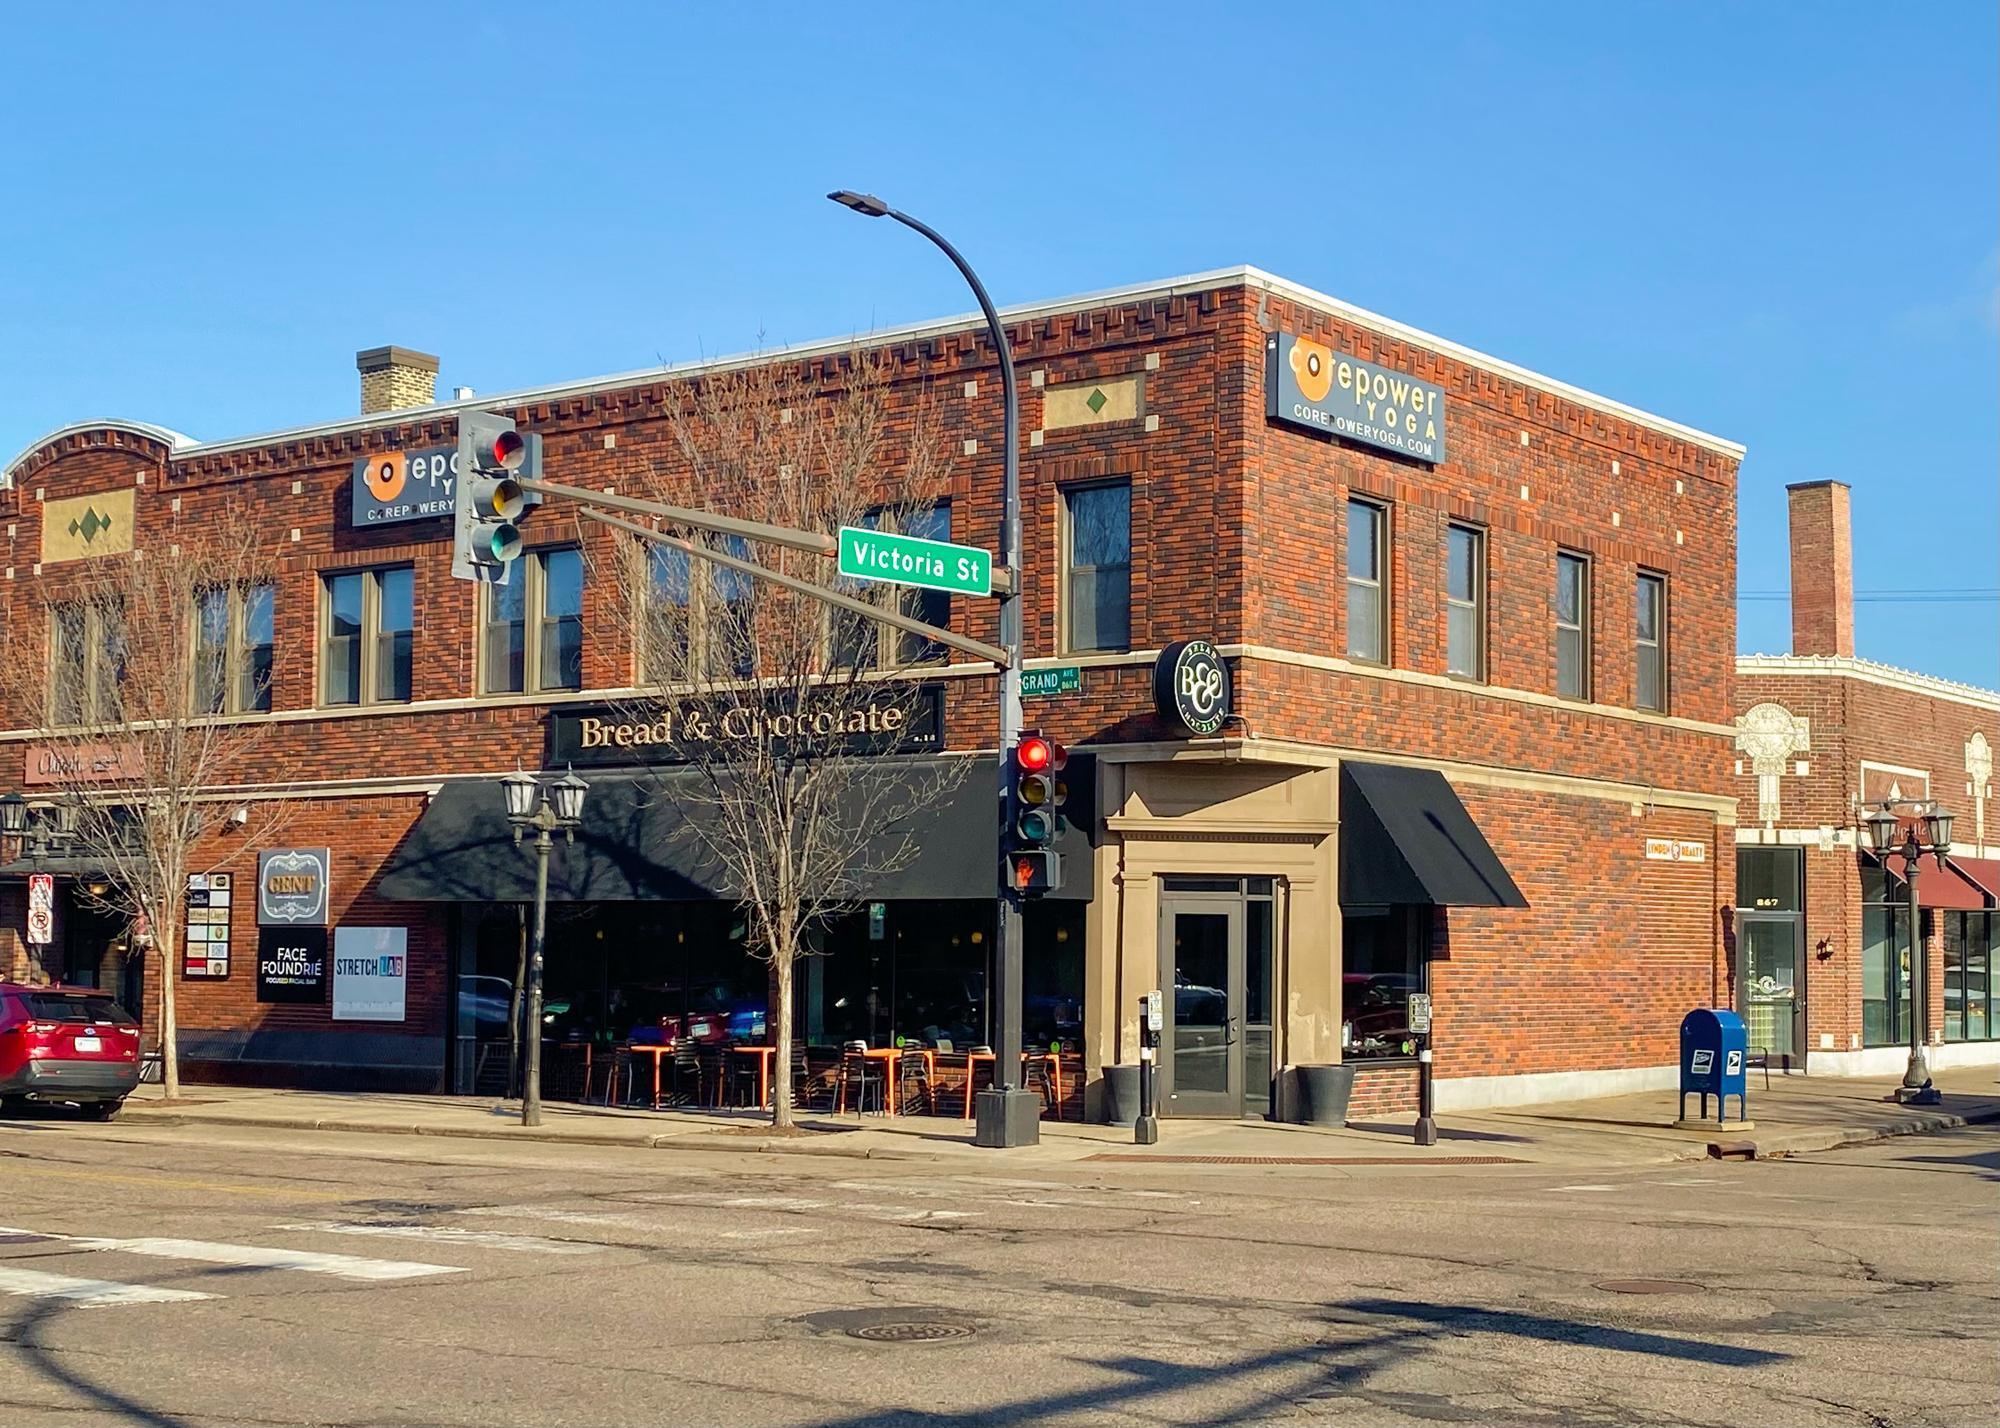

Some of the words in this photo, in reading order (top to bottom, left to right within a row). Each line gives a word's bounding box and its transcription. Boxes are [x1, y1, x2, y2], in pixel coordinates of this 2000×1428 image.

[1293, 402, 1433, 457] COREPOWERYOGA.COM
[1366, 400, 1437, 441] YOGA
[853, 540, 944, 578] Victoria
[956, 557, 980, 583] St
[1022, 673, 1058, 690] GRAND
[1062, 669, 1074, 677] AVE
[579, 711, 674, 748] Bread
[683, 711, 713, 740] &
[722, 702, 903, 739] Chocolate
[268, 874, 316, 894] GENT
[1756, 898, 1779, 906] 867
[276, 947, 308, 962] FACE
[261, 958, 322, 976] FOUNDRIÉ
